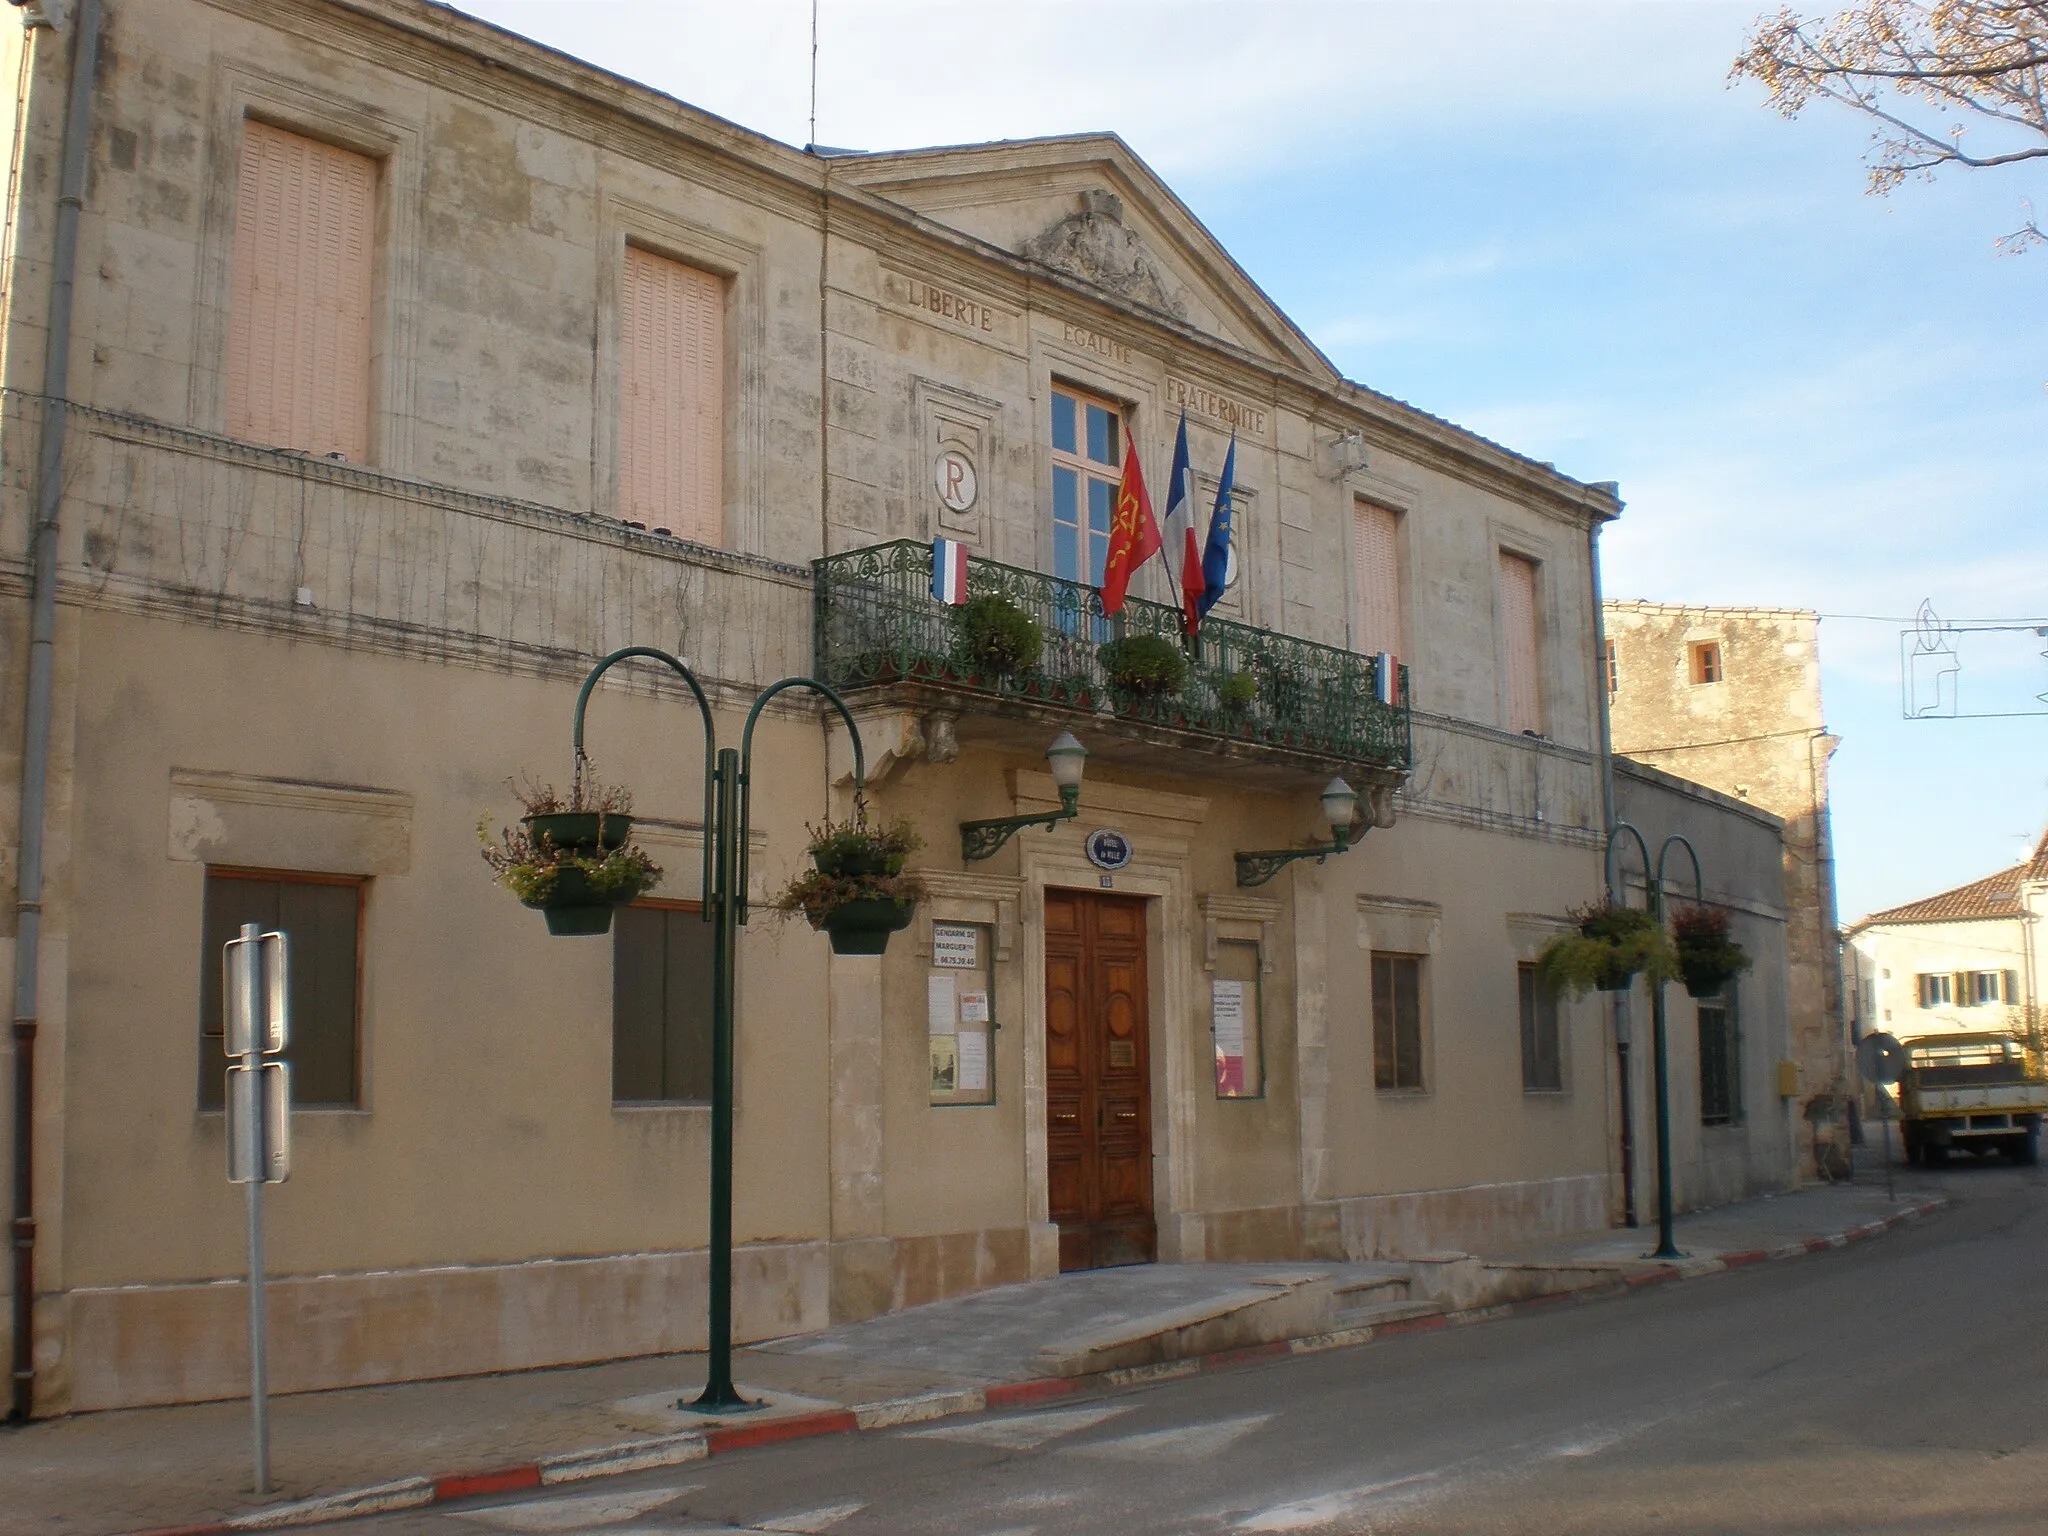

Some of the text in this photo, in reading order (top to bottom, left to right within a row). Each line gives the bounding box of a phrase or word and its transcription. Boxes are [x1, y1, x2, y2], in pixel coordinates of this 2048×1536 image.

[909, 279, 993, 332] LIBERTE
[1063, 323, 1132, 365] EGALITE
[1166, 377, 1265, 434] FRATERNITE
[945, 459, 965, 504] R
